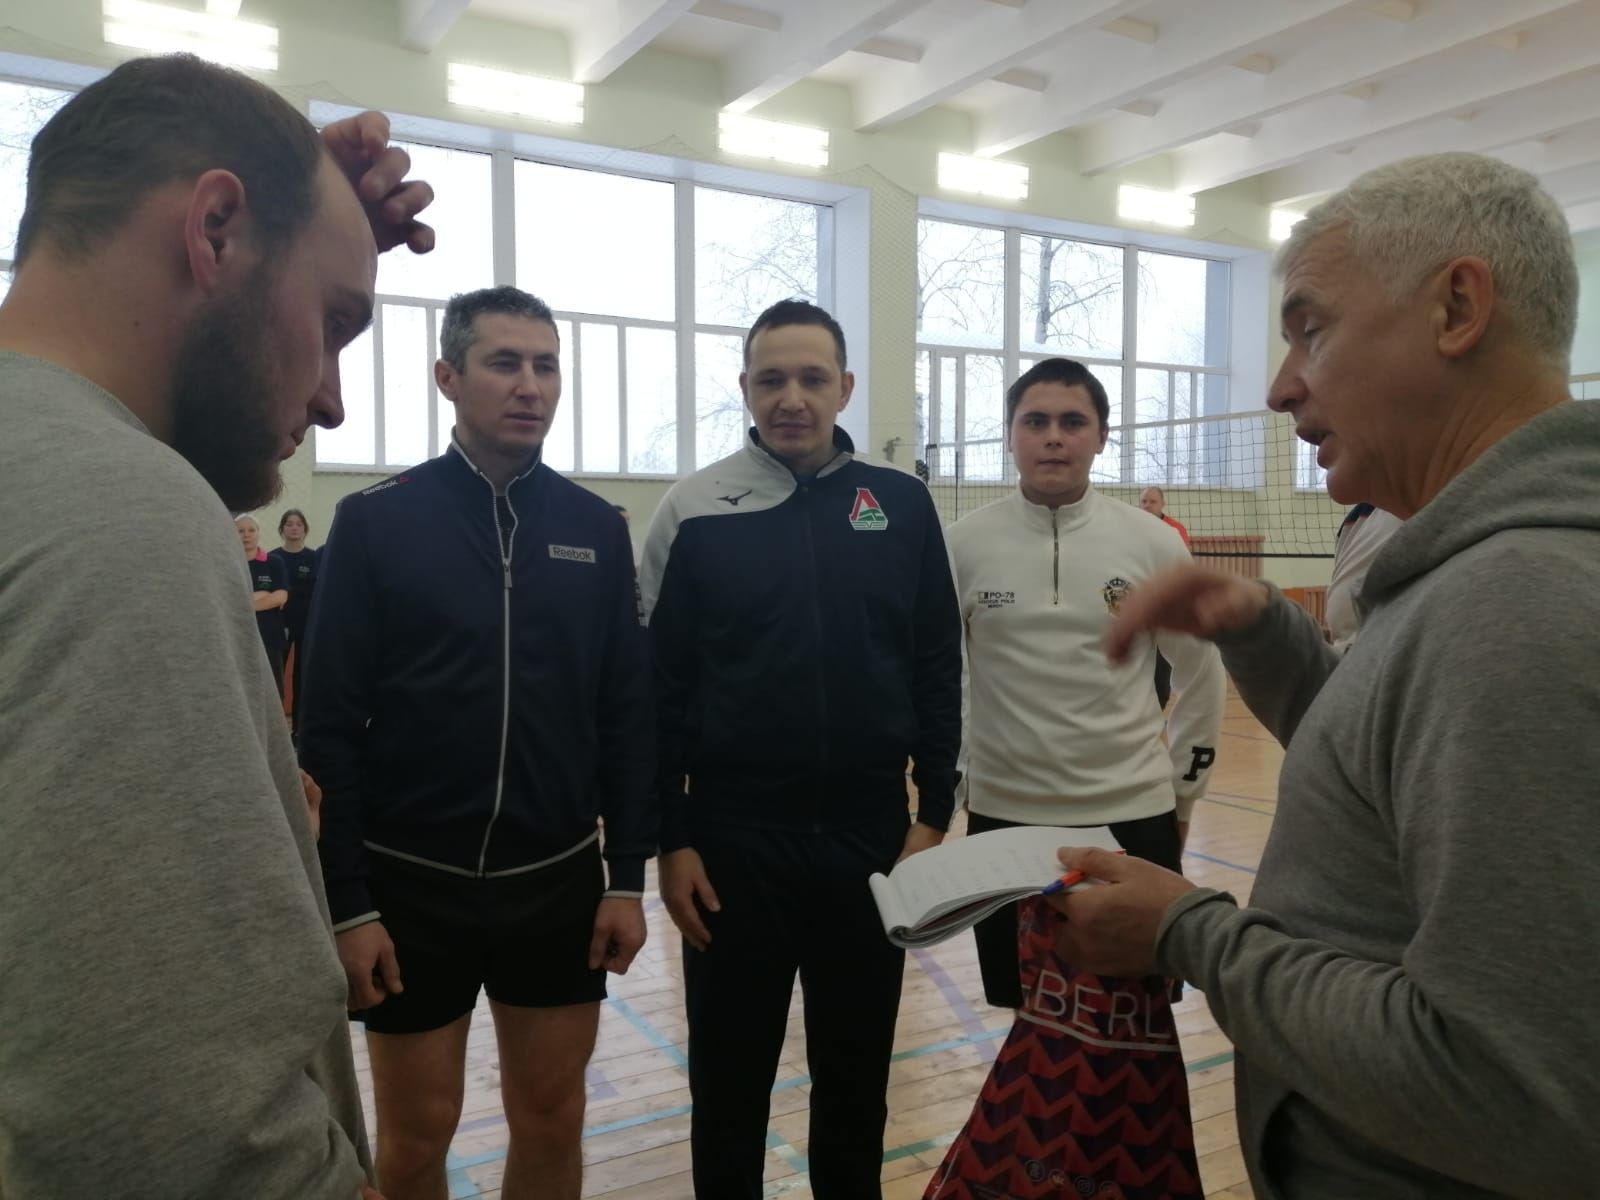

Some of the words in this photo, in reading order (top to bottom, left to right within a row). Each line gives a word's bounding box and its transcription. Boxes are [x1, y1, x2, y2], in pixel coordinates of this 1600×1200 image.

[362, 480, 399, 496] Reebok
[552, 546, 592, 561] Reebok
[1182, 746, 1216, 781] P
